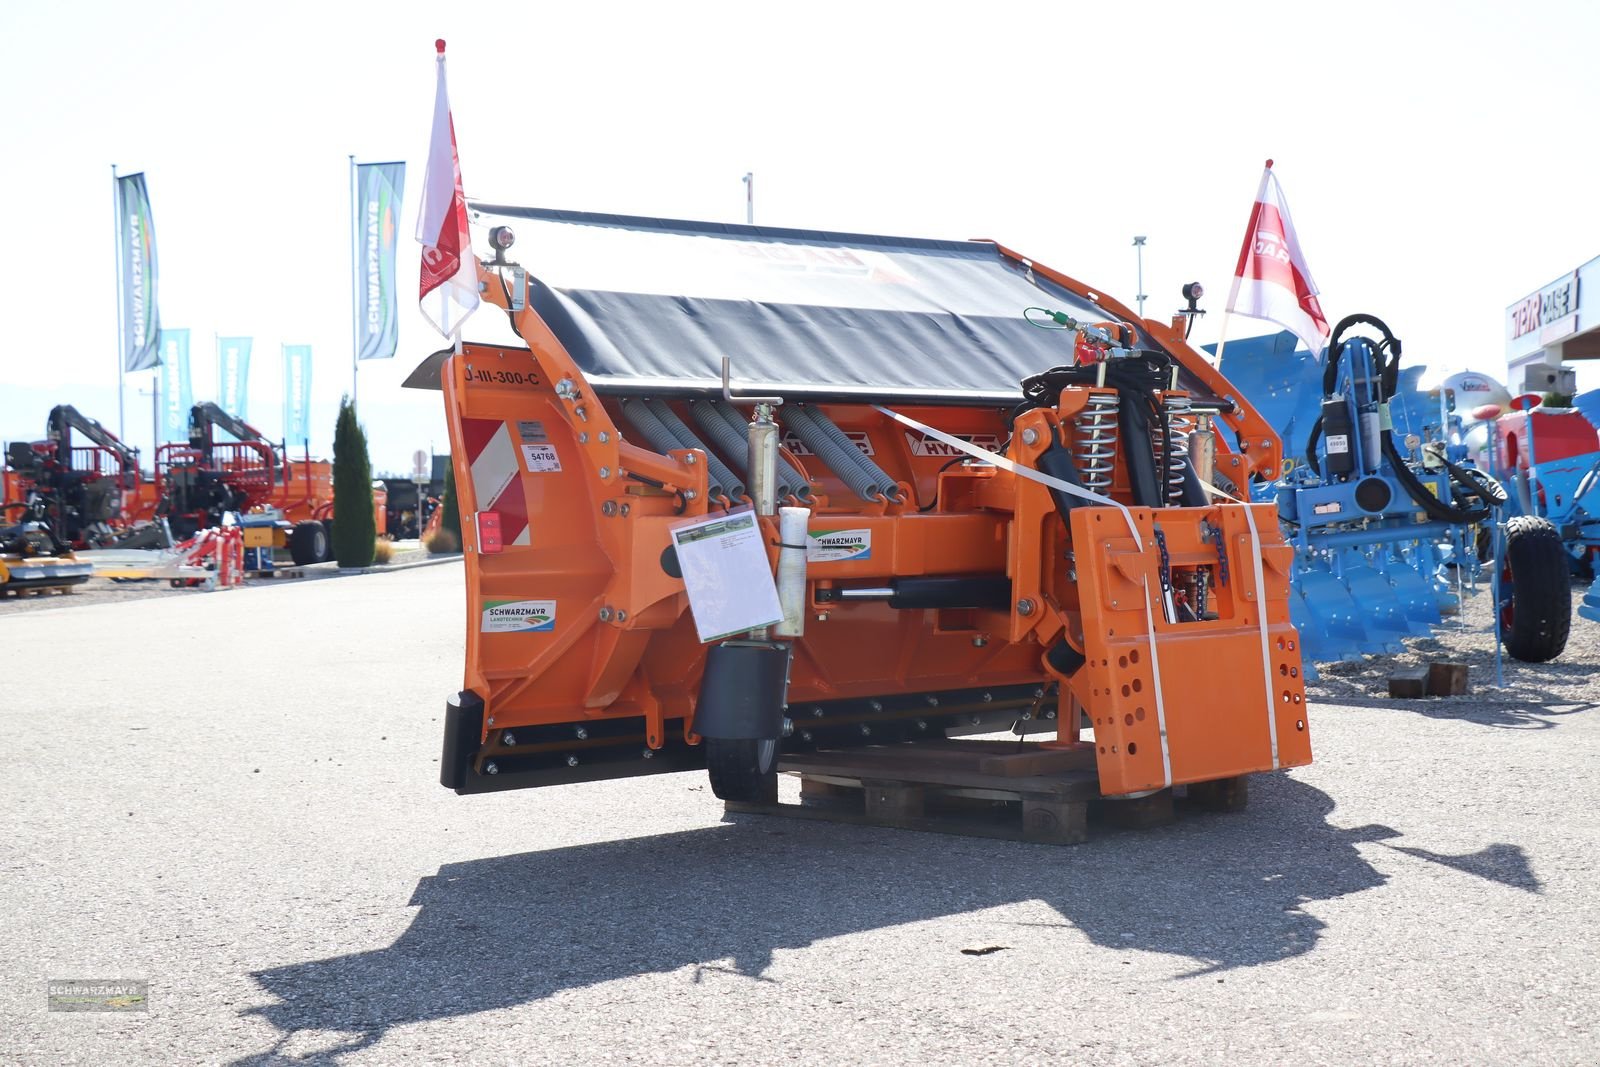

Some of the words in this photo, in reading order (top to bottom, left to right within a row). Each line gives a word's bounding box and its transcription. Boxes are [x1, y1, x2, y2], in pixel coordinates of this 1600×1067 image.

[130, 213, 145, 347] SCHWARZMAYR
[368, 200, 381, 334] SCHWARZMAYR
[531, 453, 556, 461] 54768
[489, 608, 546, 616] SCHWARZMAYR
